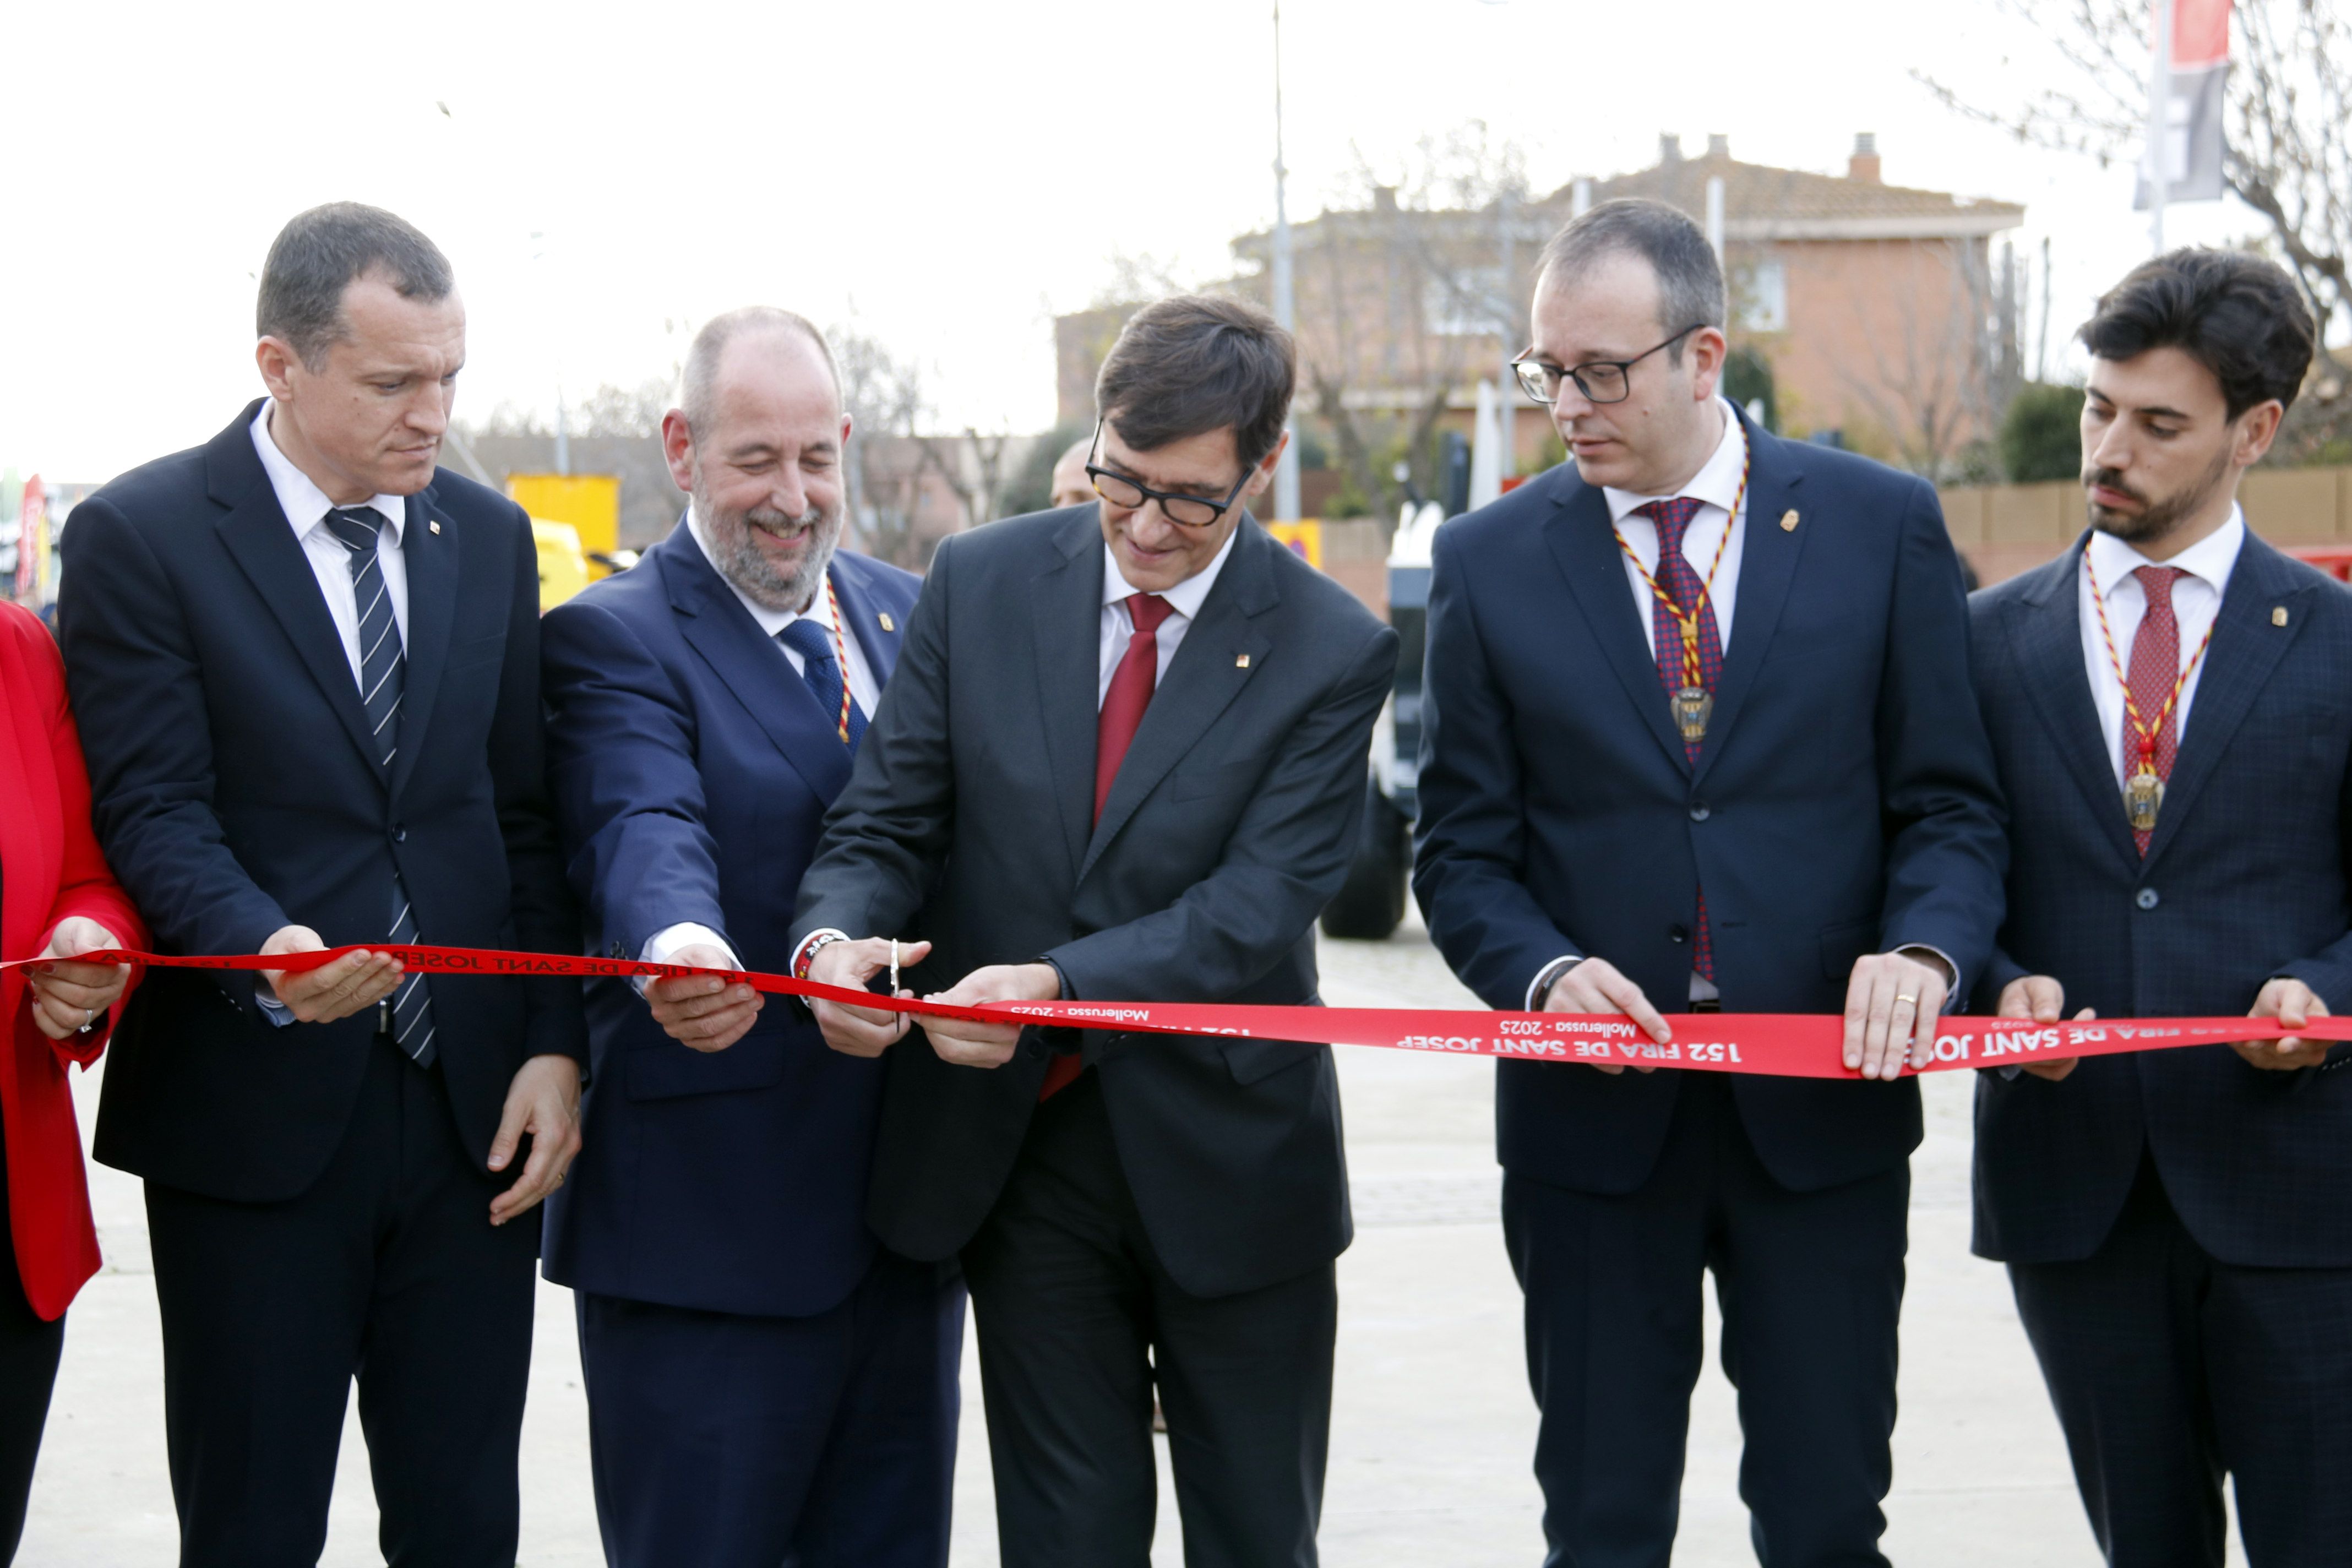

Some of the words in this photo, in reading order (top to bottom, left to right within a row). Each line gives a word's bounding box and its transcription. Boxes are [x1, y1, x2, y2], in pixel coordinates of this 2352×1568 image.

[1068, 1007, 1149, 1021] Mollerussa
[1499, 1020, 1542, 1035] 2025
[1555, 1021, 1637, 1038] Mollerussa
[2069, 1026, 2108, 1044] DE
[2115, 1027, 2181, 1040] FIRA
[1396, 1035, 1483, 1052] JOSEP
[1490, 1037, 1566, 1056] SANT
[1574, 1040, 1611, 1058] DE
[1616, 1041, 1681, 1060] FIRA
[1981, 1028, 2060, 1057] SANT
[1686, 1043, 1743, 1063] 152
